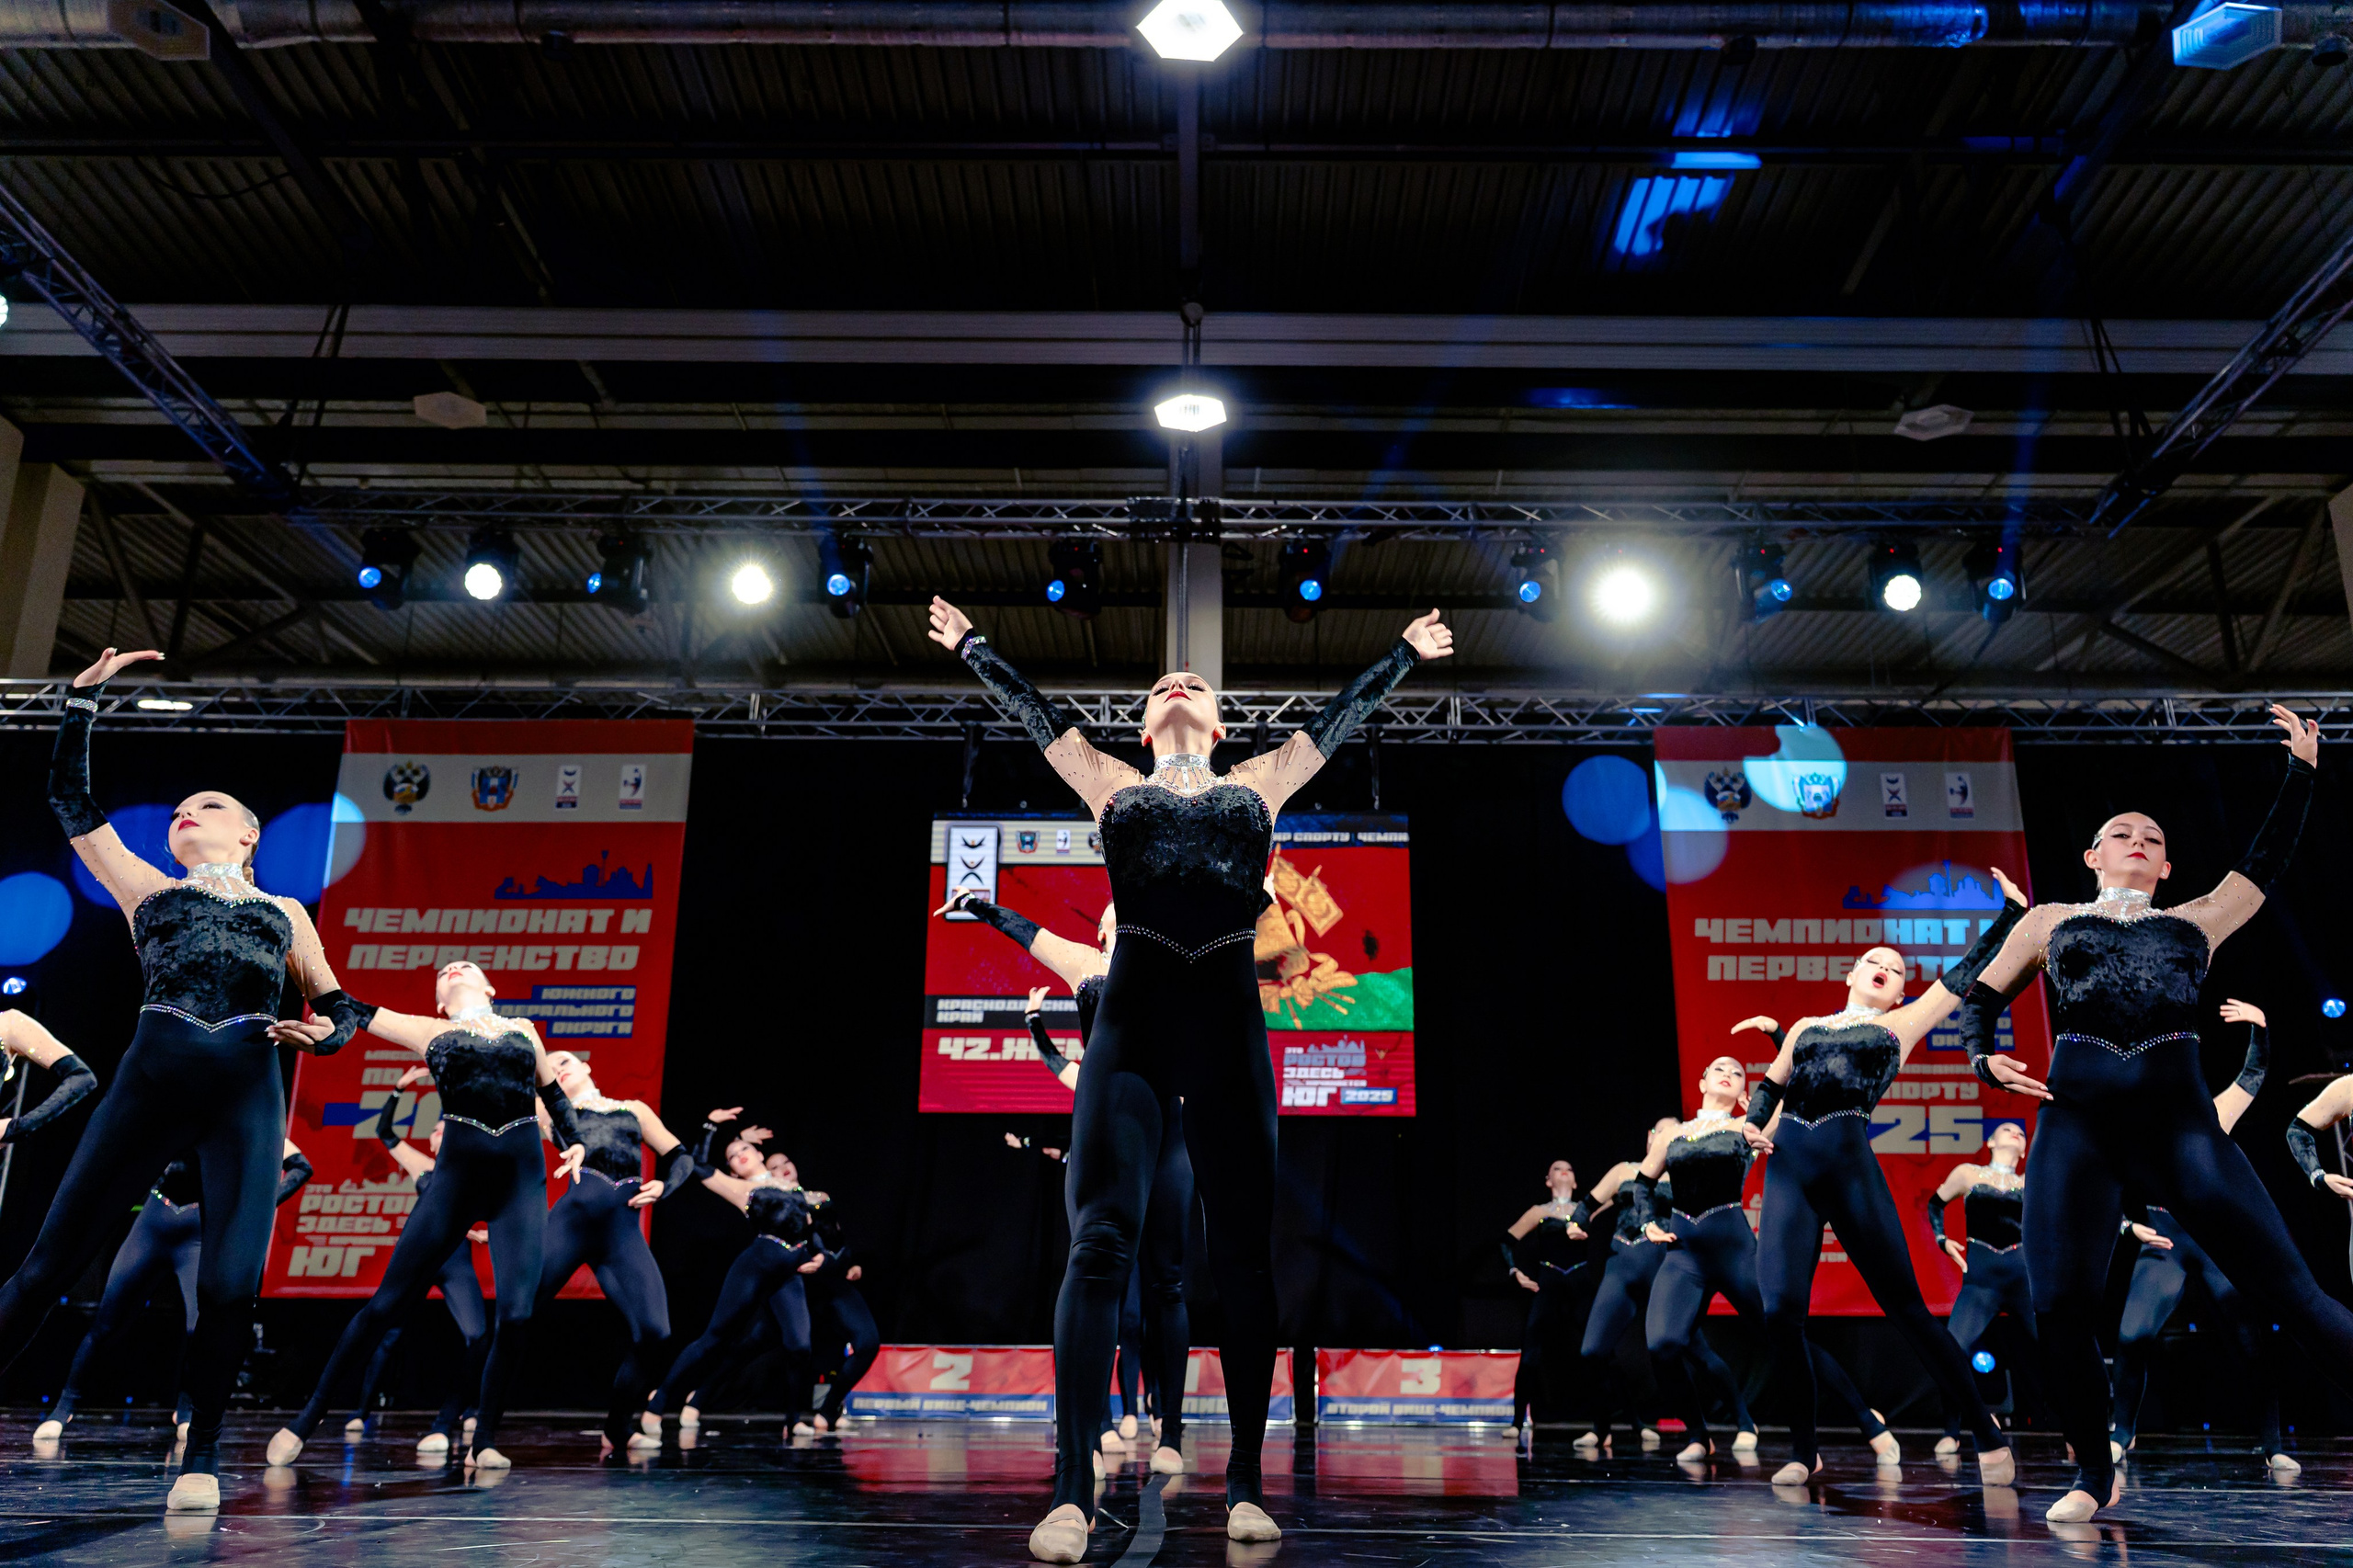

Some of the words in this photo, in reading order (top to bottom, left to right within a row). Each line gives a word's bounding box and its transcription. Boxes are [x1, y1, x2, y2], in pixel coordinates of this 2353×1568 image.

[1273, 832, 1292, 843] ИР
[1293, 832, 1350, 843] СПОРТУ
[344, 908, 614, 934] ЧЕМПИОНАТ
[620, 909, 653, 934] И
[1694, 918, 1971, 945] ЧЕМПИОНАТ
[347, 944, 640, 971] ПЕРВЕНСТВО
[1708, 955, 1964, 982] ПЕРВЕСТ
[541, 987, 635, 1000] ЮЖНОГО
[493, 1005, 634, 1017] ДЕРАЛЬНОГО
[937, 998, 1078, 1011] КРАСНОДАСКИ
[552, 1021, 633, 1034] ОКРУГА
[1283, 1053, 1367, 1067] РОСТОВ
[361, 1068, 404, 1085] ПО
[1282, 1066, 1345, 1079] ЗДЕСЬ
[1281, 1085, 1337, 1107] ЮГ
[1881, 1082, 1979, 1100] ПОРТУ
[1870, 1105, 1984, 1154] 25
[296, 1215, 392, 1233] ЗДЕСЬ
[288, 1245, 376, 1277] ЮГ
[929, 1354, 973, 1391] 2
[1399, 1358, 1442, 1394] 3
